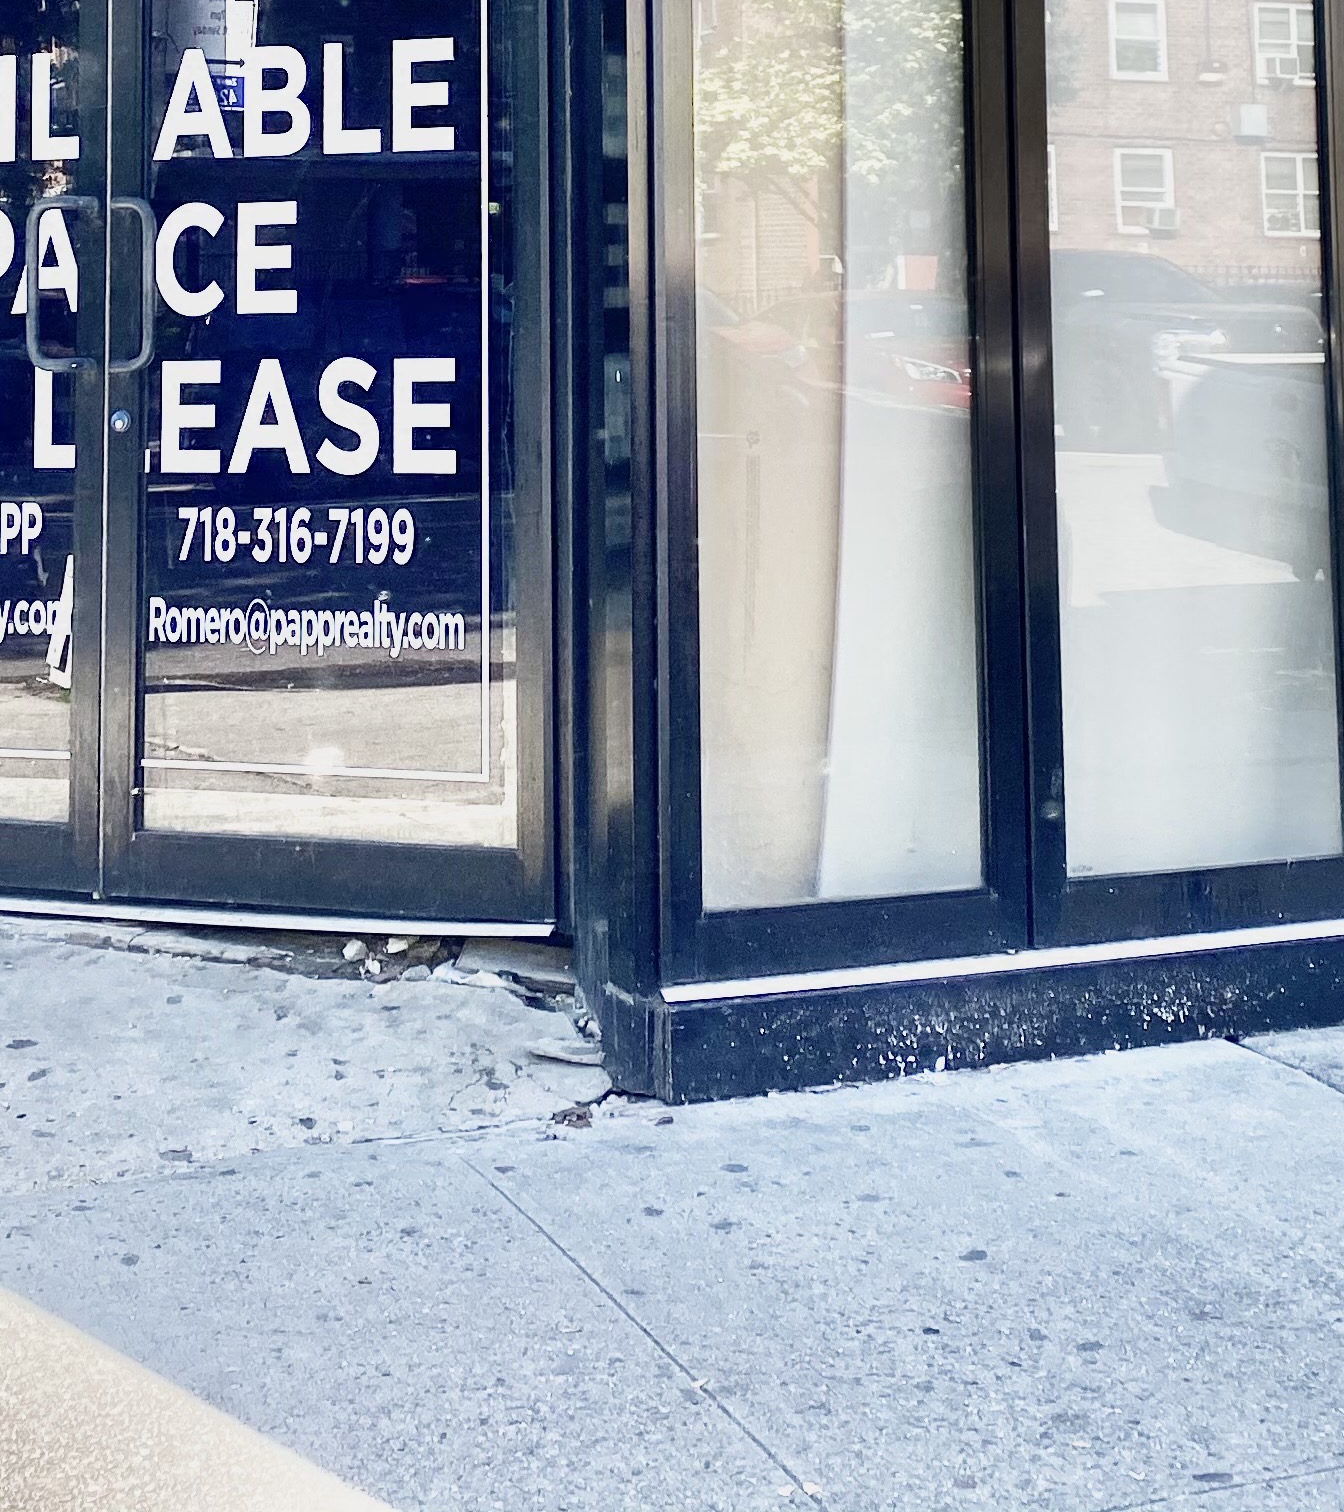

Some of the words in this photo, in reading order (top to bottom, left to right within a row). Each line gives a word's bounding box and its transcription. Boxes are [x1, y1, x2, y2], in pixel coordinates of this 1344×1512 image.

[33, 356, 457, 476] LEASE
[177, 507, 415, 566] 718-316-7199
[147, 595, 466, 657] Romero@papprealty.com
